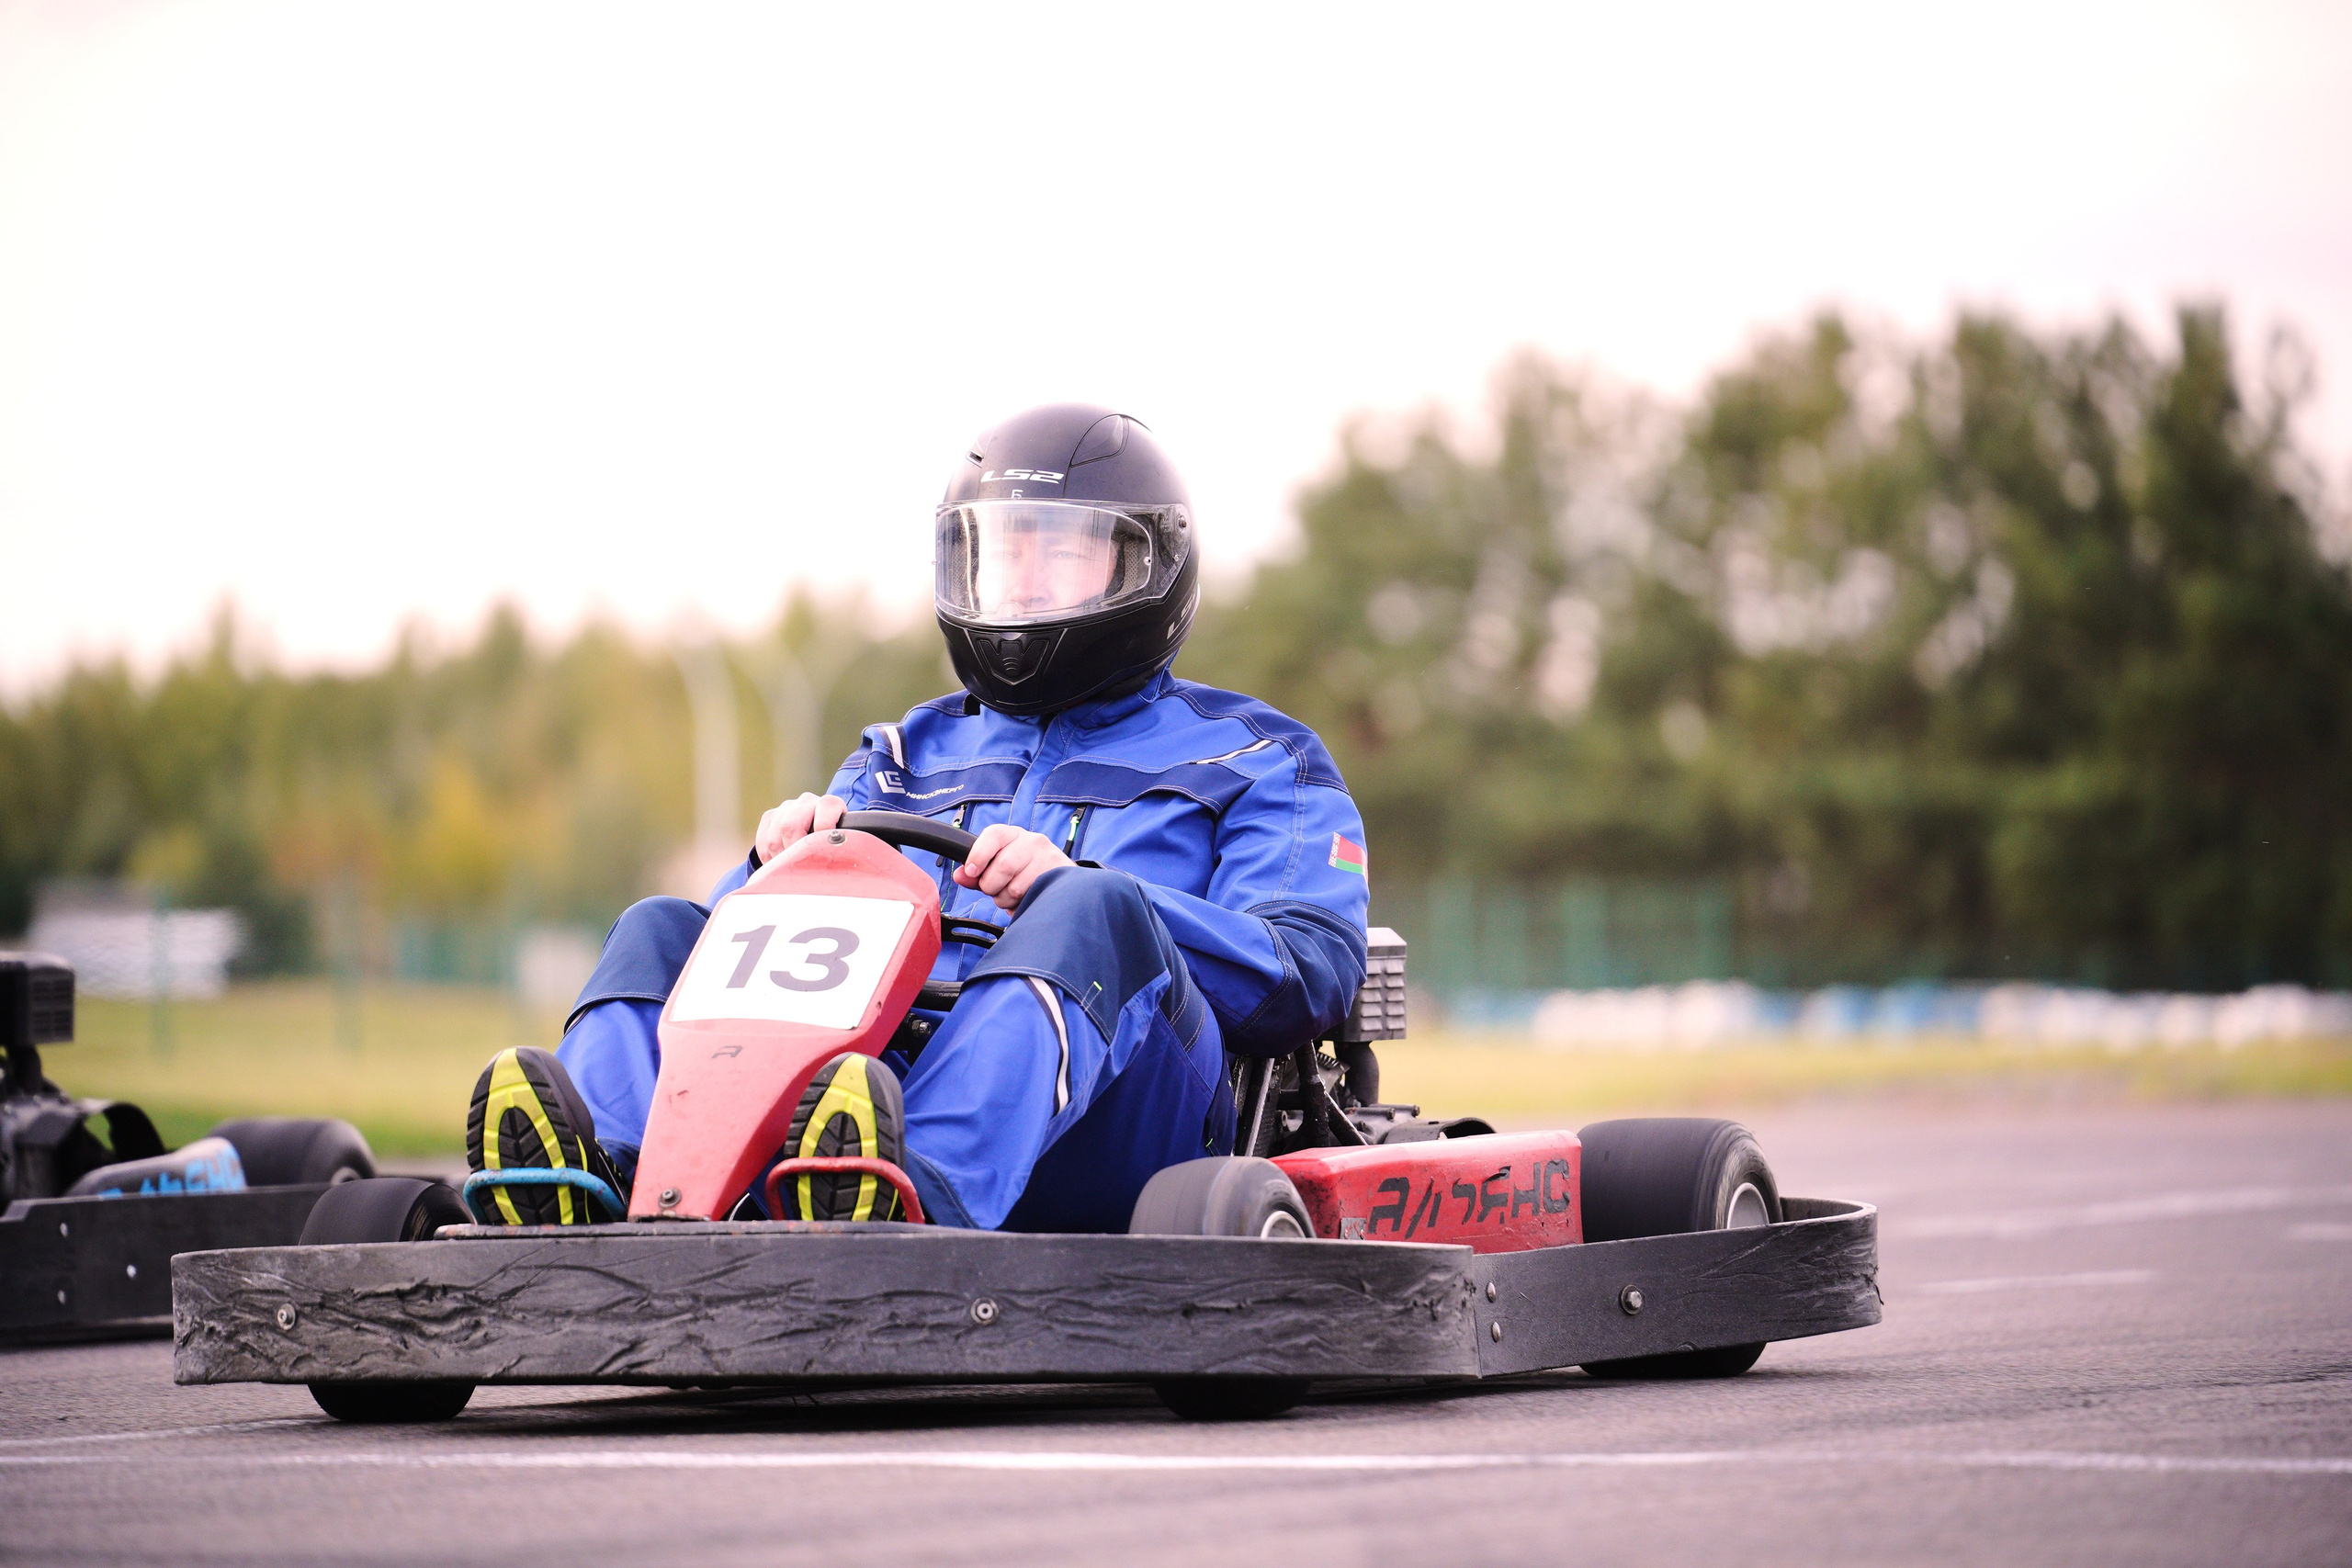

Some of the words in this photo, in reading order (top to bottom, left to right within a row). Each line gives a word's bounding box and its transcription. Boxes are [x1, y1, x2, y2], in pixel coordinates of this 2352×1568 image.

[980, 468, 1065, 484] LS2
[906, 784, 965, 800] МИНСКЭНЕРГО
[726, 925, 860, 992] 13
